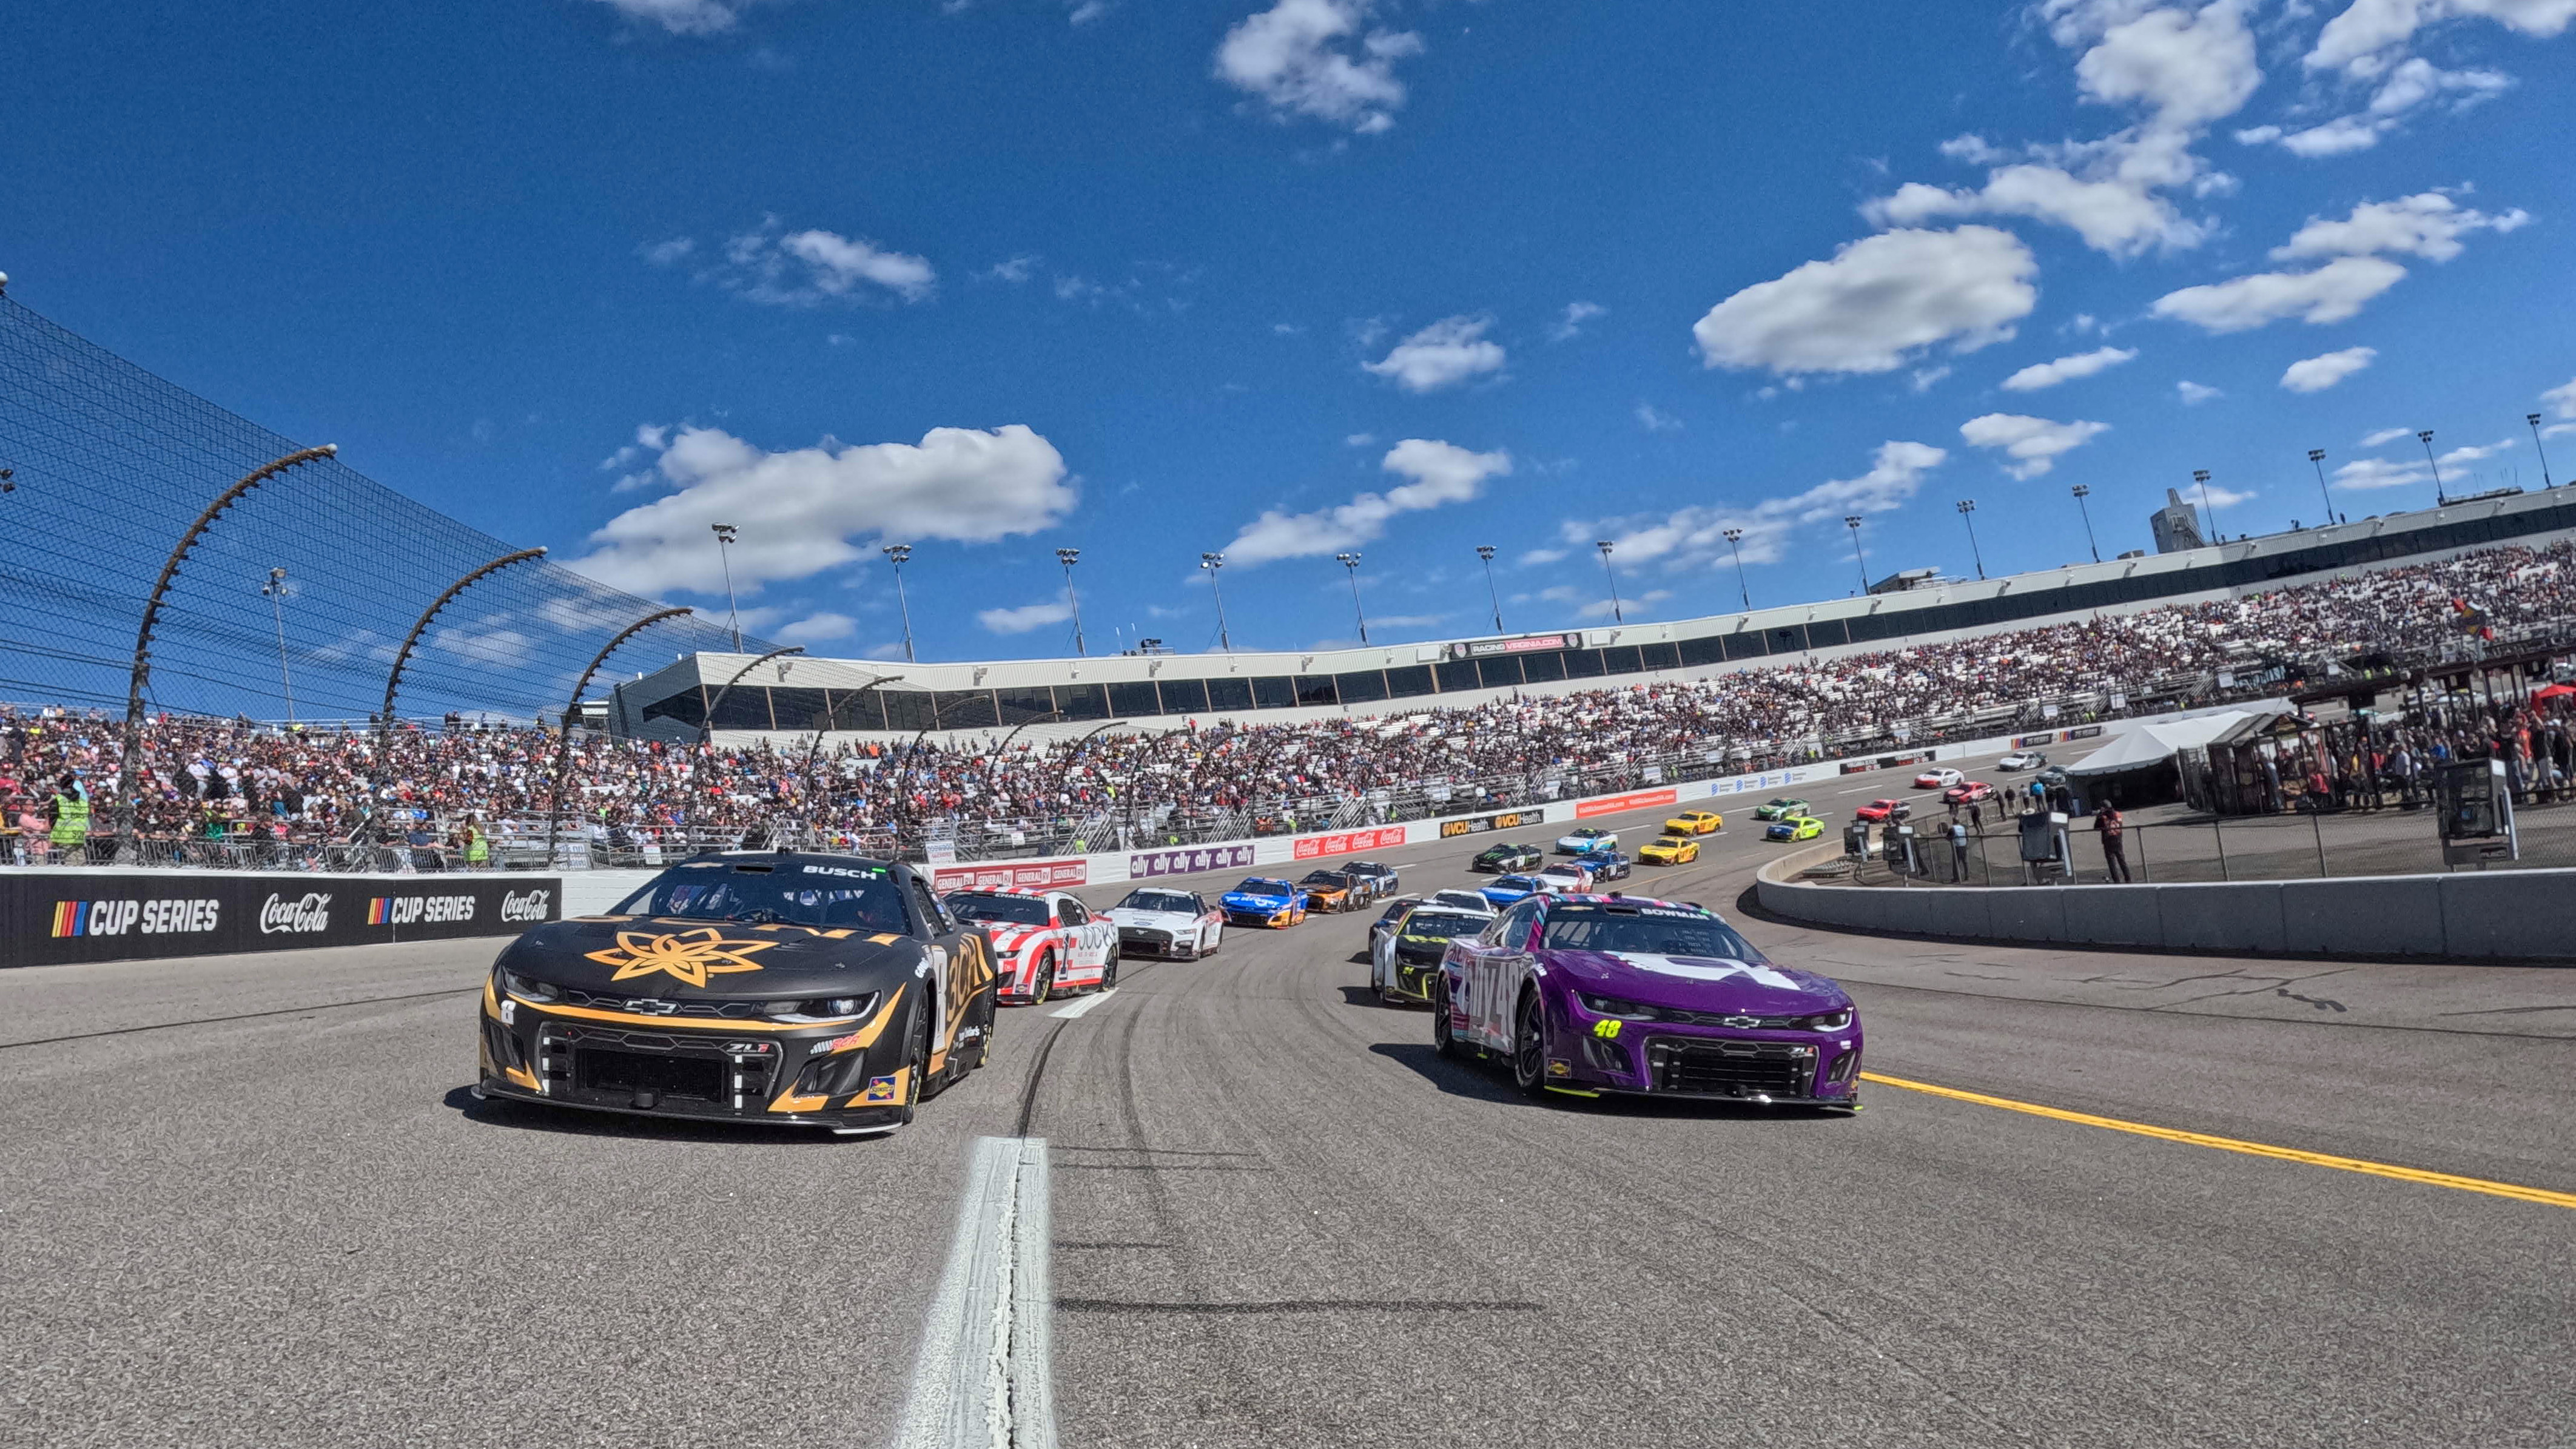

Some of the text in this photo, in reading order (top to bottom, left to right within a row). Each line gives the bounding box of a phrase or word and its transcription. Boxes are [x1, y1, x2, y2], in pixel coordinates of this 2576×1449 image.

[807, 732, 813, 741] H
[1154, 853, 1171, 874] ally
[1174, 852, 1191, 872] ally
[1195, 850, 1212, 870] ally
[1216, 848, 1233, 867] ally
[1237, 847, 1253, 865] ally
[802, 866, 876, 879] BUSCH
[1054, 867, 1085, 880] GENERAL RV
[1131, 855, 1149, 877] ally
[937, 876, 964, 890] GENERAL
[978, 874, 1003, 886] GENERAL
[1017, 870, 1050, 883] GENERAL RV
[501, 889, 551, 923] Coca-Cola
[995, 893, 1046, 903] CHASTAIN
[89, 899, 220, 936] CUP SERIES
[260, 893, 332, 934] Coca-Cola
[391, 895, 475, 923] CUP SERIES
[1641, 908, 1710, 920] BOWMAN
[501, 1000, 516, 1025] 8
[1594, 1020, 1621, 1038] 48
